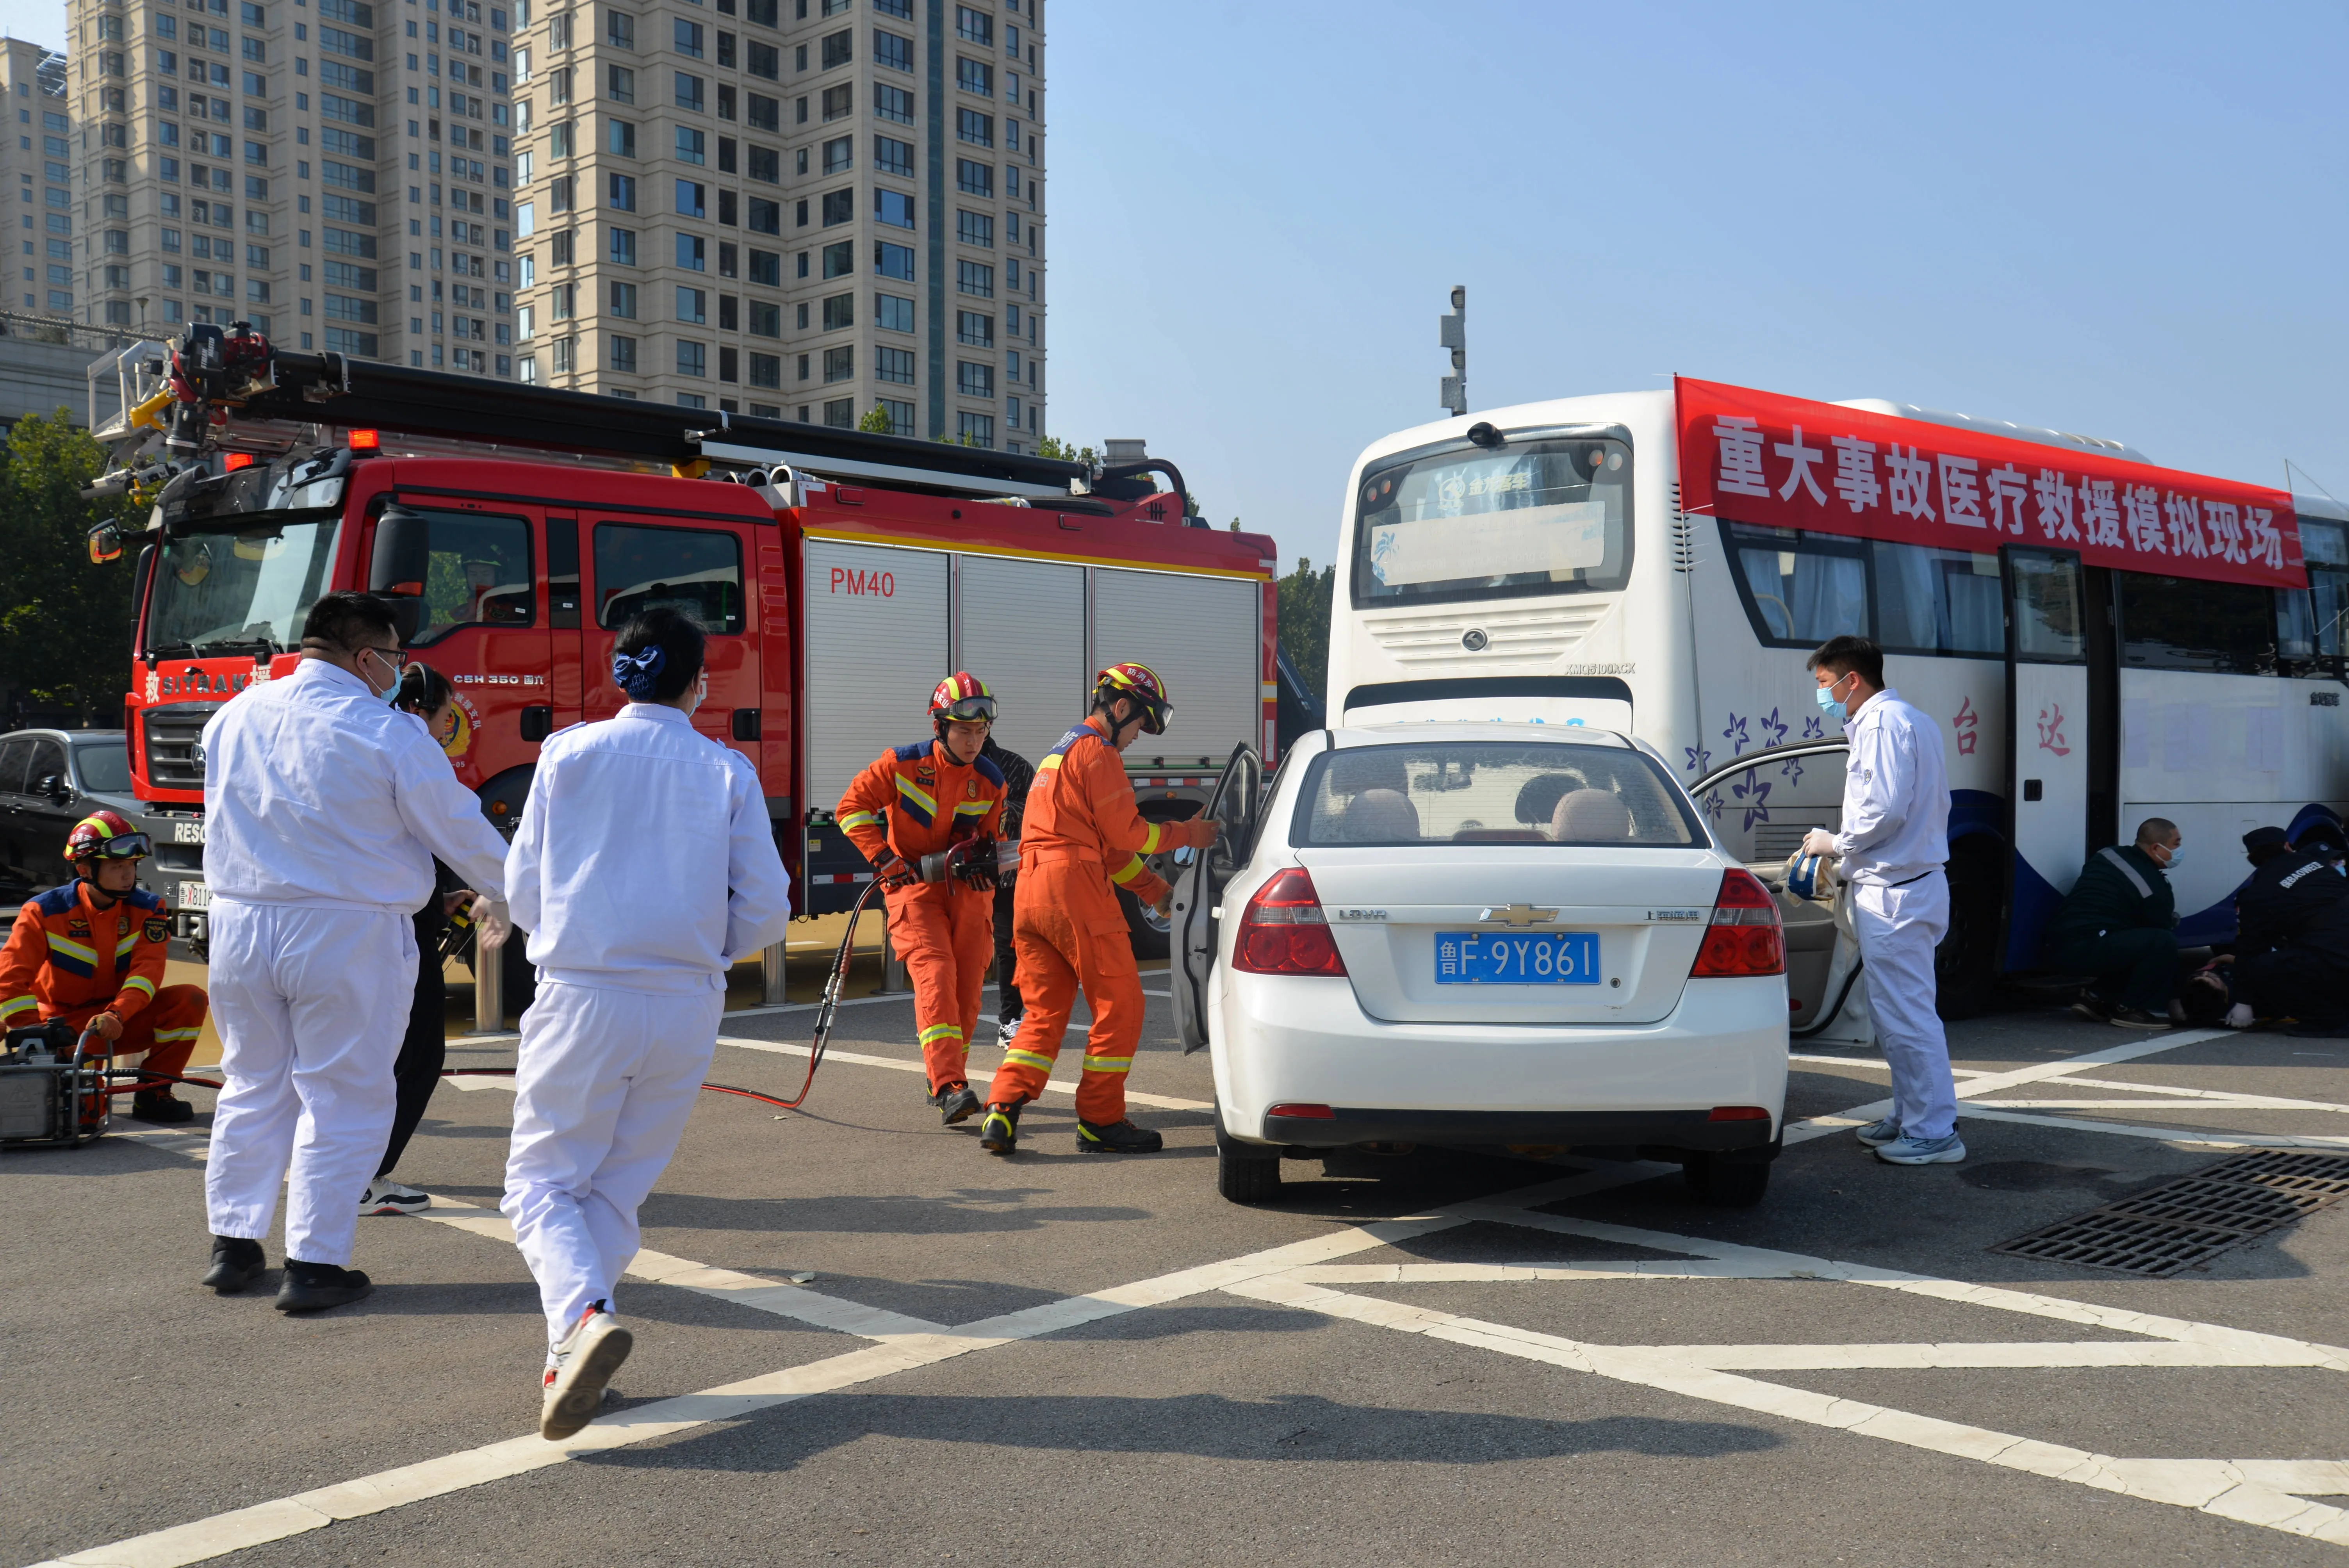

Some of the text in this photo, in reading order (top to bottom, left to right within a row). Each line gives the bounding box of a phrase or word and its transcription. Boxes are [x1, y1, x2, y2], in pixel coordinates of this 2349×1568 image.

[1712, 414, 2283, 570] 重大事故医疗救援模拟现场
[831, 568, 894, 597] PM40
[145, 670, 159, 704] 救
[162, 674, 247, 695] SITRAK
[488, 675, 519, 684] 350
[524, 675, 544, 684] 国六
[2037, 703, 2070, 757] 达
[1643, 911, 1700, 921] 上海通用
